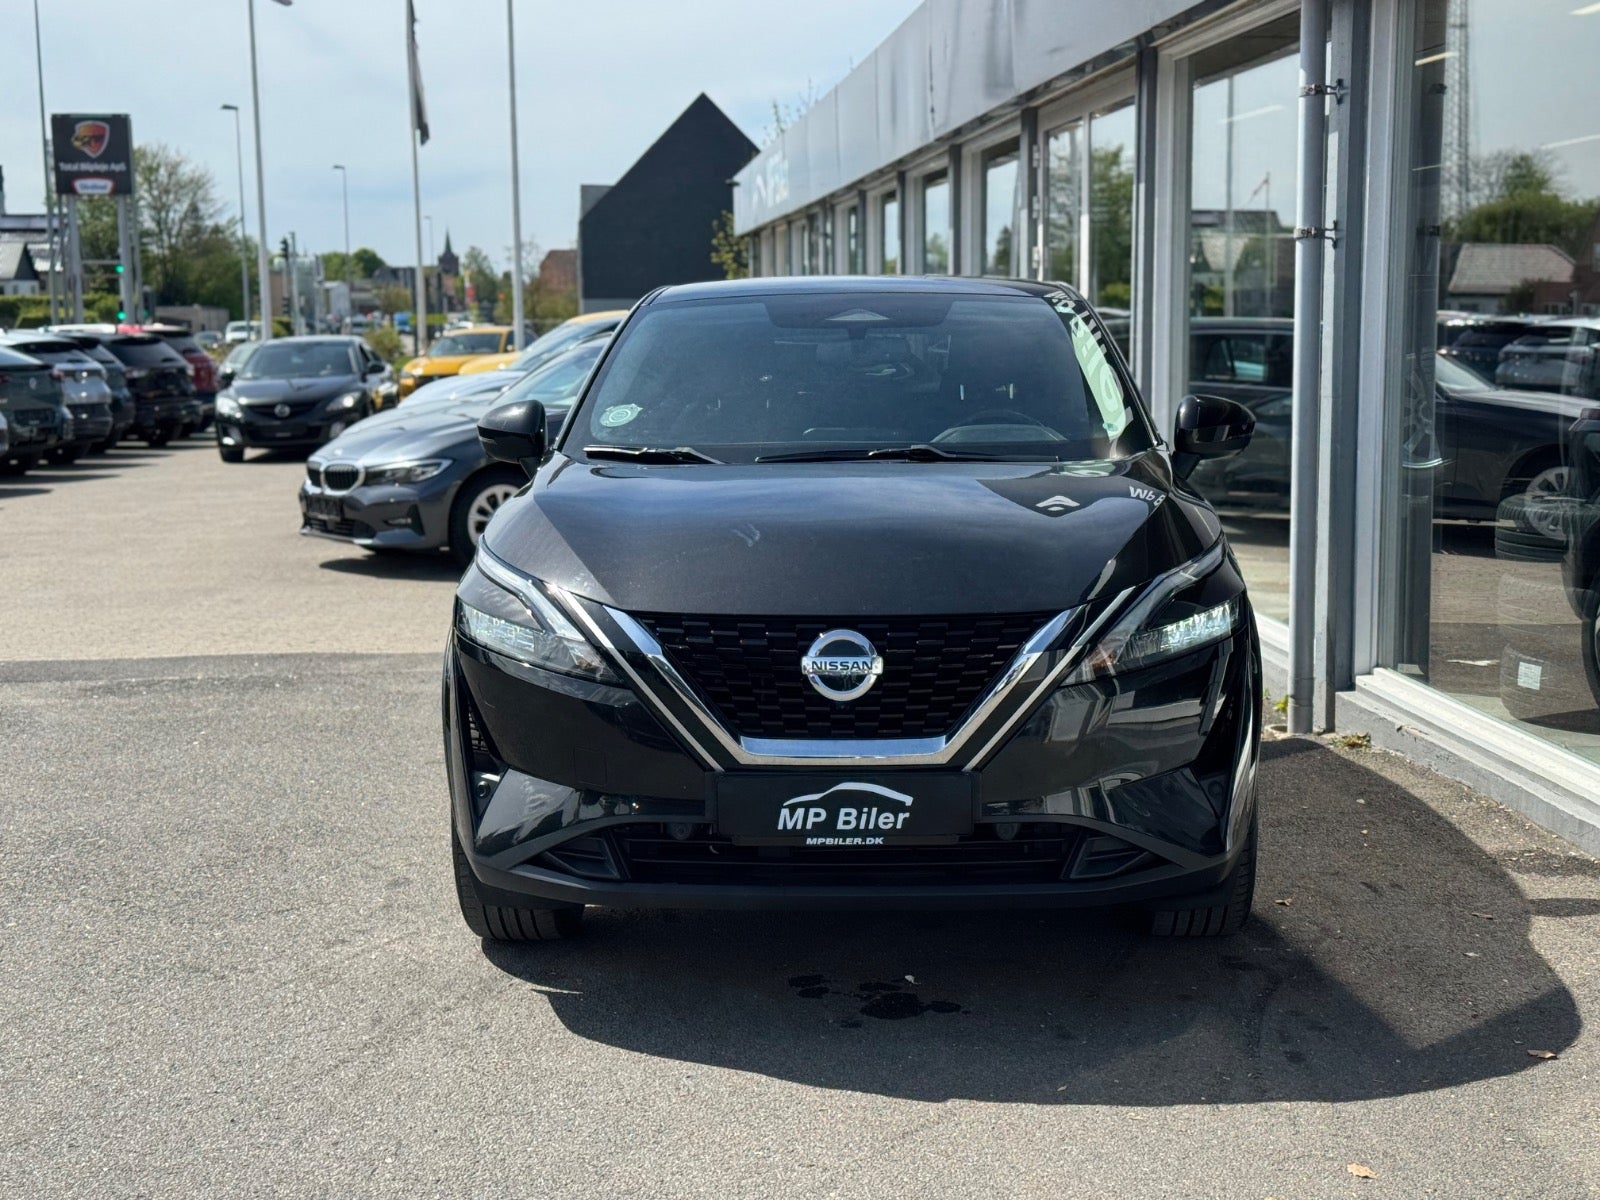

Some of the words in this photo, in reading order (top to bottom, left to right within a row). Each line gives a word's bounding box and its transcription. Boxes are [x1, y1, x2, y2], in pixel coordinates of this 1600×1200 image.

[811, 661, 873, 671] NISSAN
[777, 807, 827, 830] MP
[836, 807, 910, 830] Biler
[806, 837, 885, 845] MPBILER.DK
